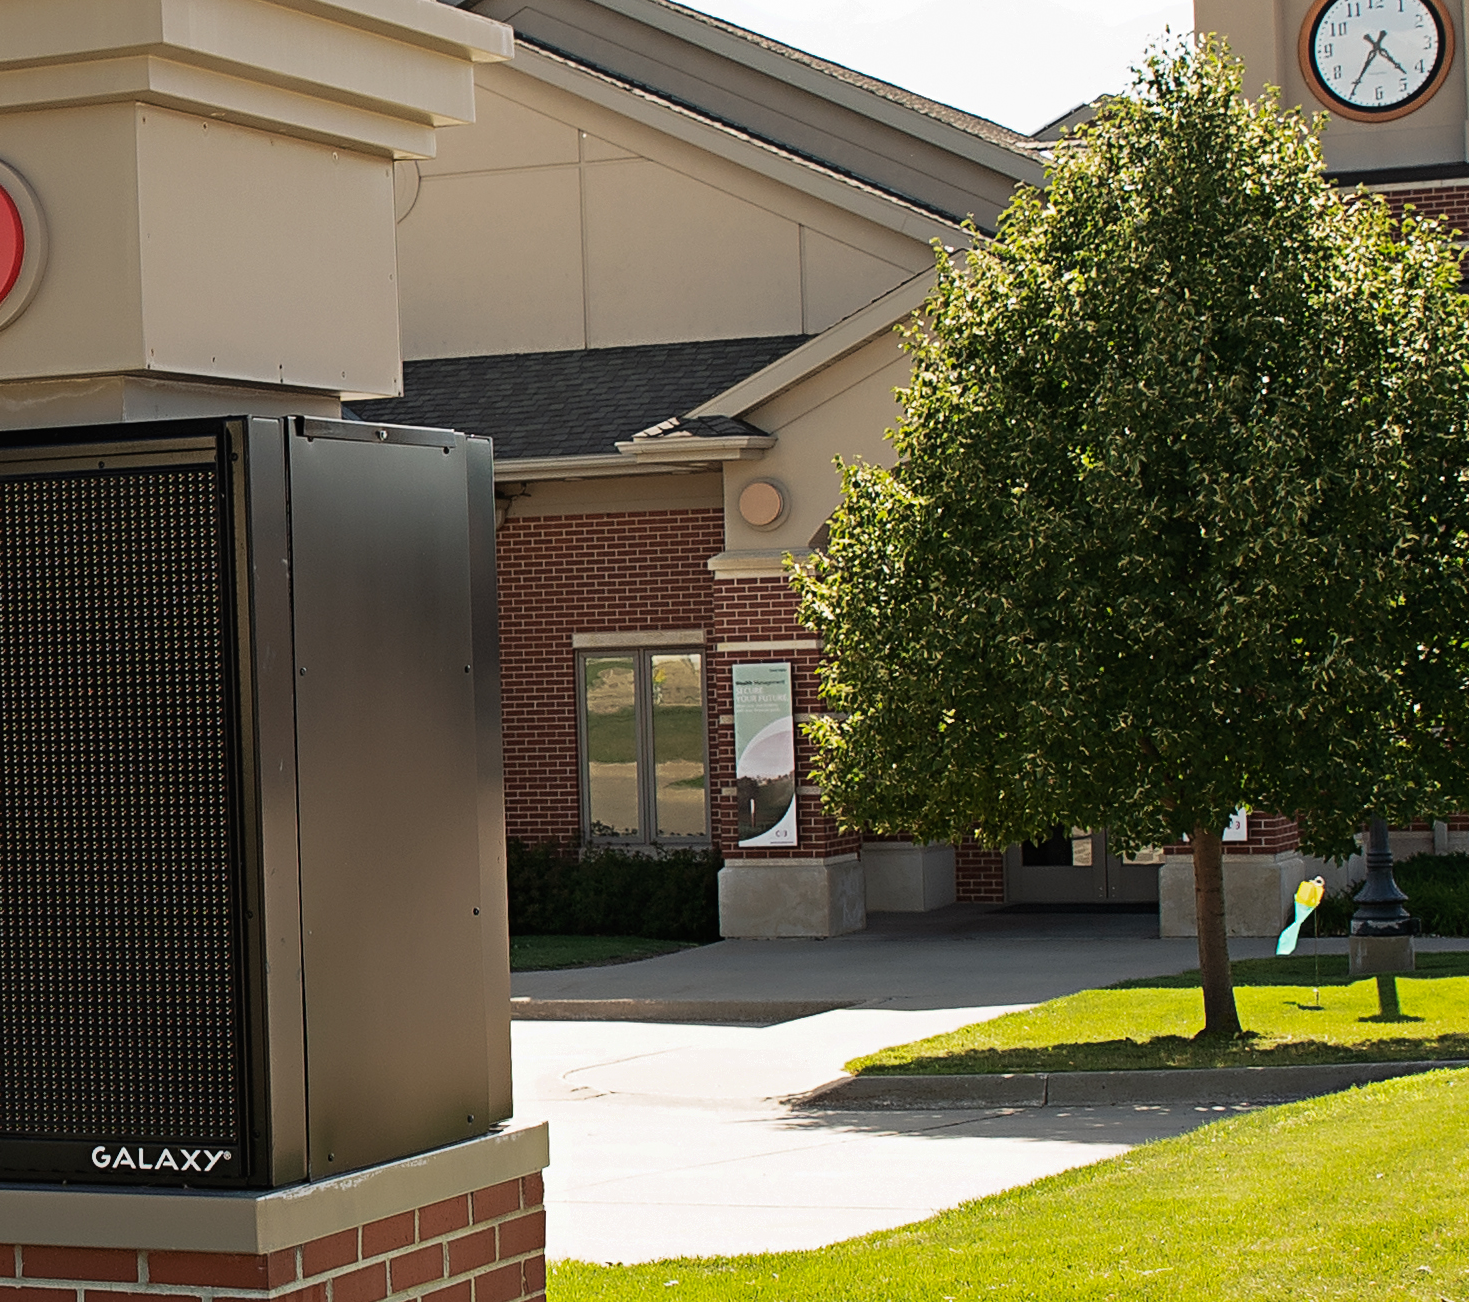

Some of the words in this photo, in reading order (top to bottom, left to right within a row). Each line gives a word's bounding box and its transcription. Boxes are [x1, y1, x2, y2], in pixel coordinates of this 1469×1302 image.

[1347, 2, 1361, 17] 11
[1415, 13, 1424, 28] 2
[1330, 22, 1347, 37] 10
[1423, 35, 1432, 49] 3
[1324, 43, 1333, 58] 9
[1333, 65, 1342, 79] 8
[1414, 59, 1425, 73] 4
[1399, 77, 1407, 92] 5
[1374, 86, 1383, 100] 6
